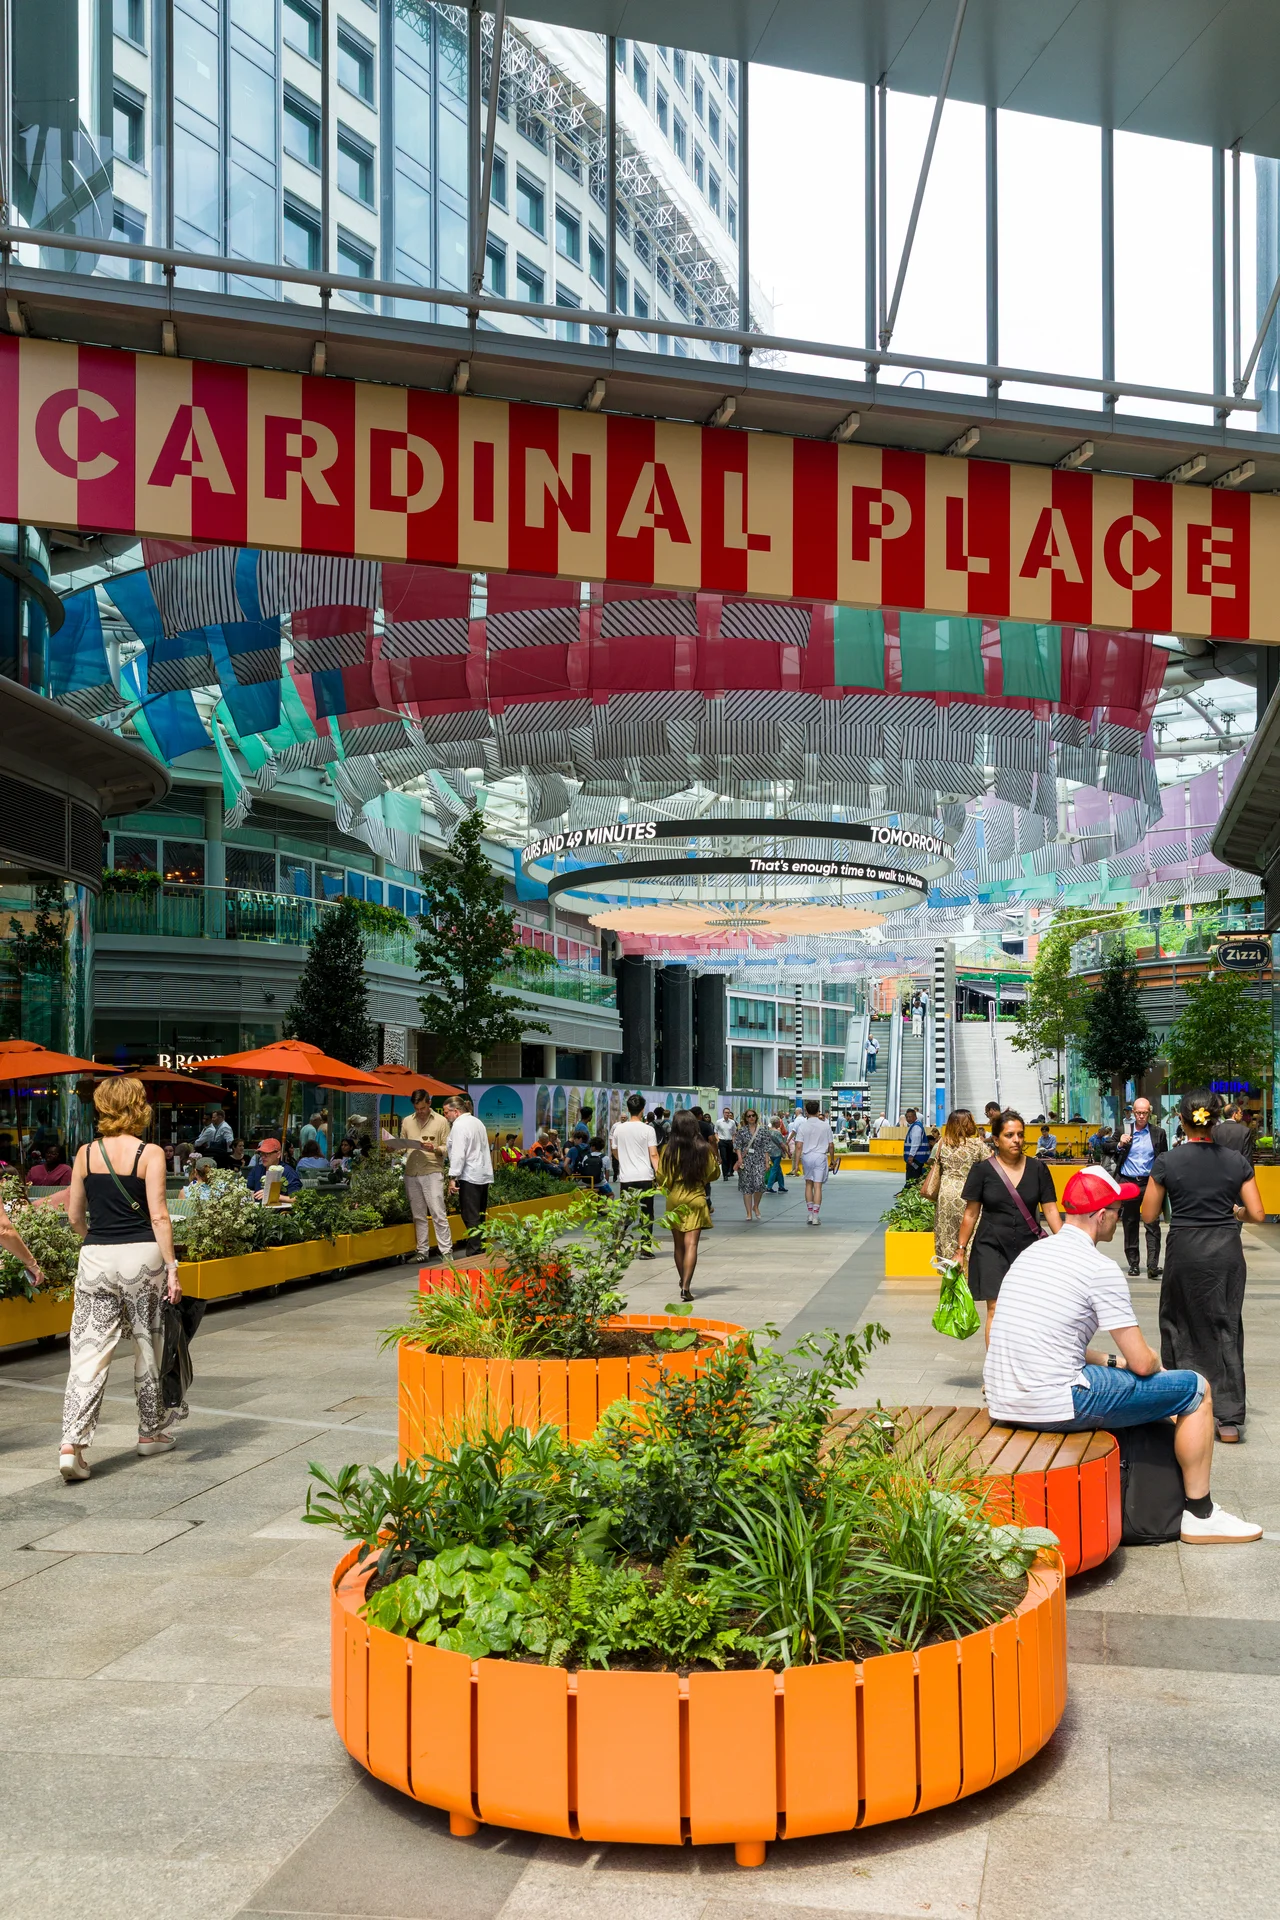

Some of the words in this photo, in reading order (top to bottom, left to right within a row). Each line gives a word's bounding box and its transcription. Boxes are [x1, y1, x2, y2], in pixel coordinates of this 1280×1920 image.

[35, 387, 771, 553] CARDINAL
[852, 485, 1236, 599] PLACE
[542, 834, 565, 855] AND
[566, 831, 583, 848] 49
[585, 822, 657, 846] MINUTES
[870, 826, 942, 855] TOMORROW
[750, 859, 789, 872] That's
[791, 861, 838, 876] enough
[841, 864, 864, 878] time
[866, 867, 876, 878] to
[878, 869, 897, 882] walk
[897, 872, 905, 883] to
[905, 873, 923, 888] Marlow
[1226, 949, 1261, 960] Zizzi
